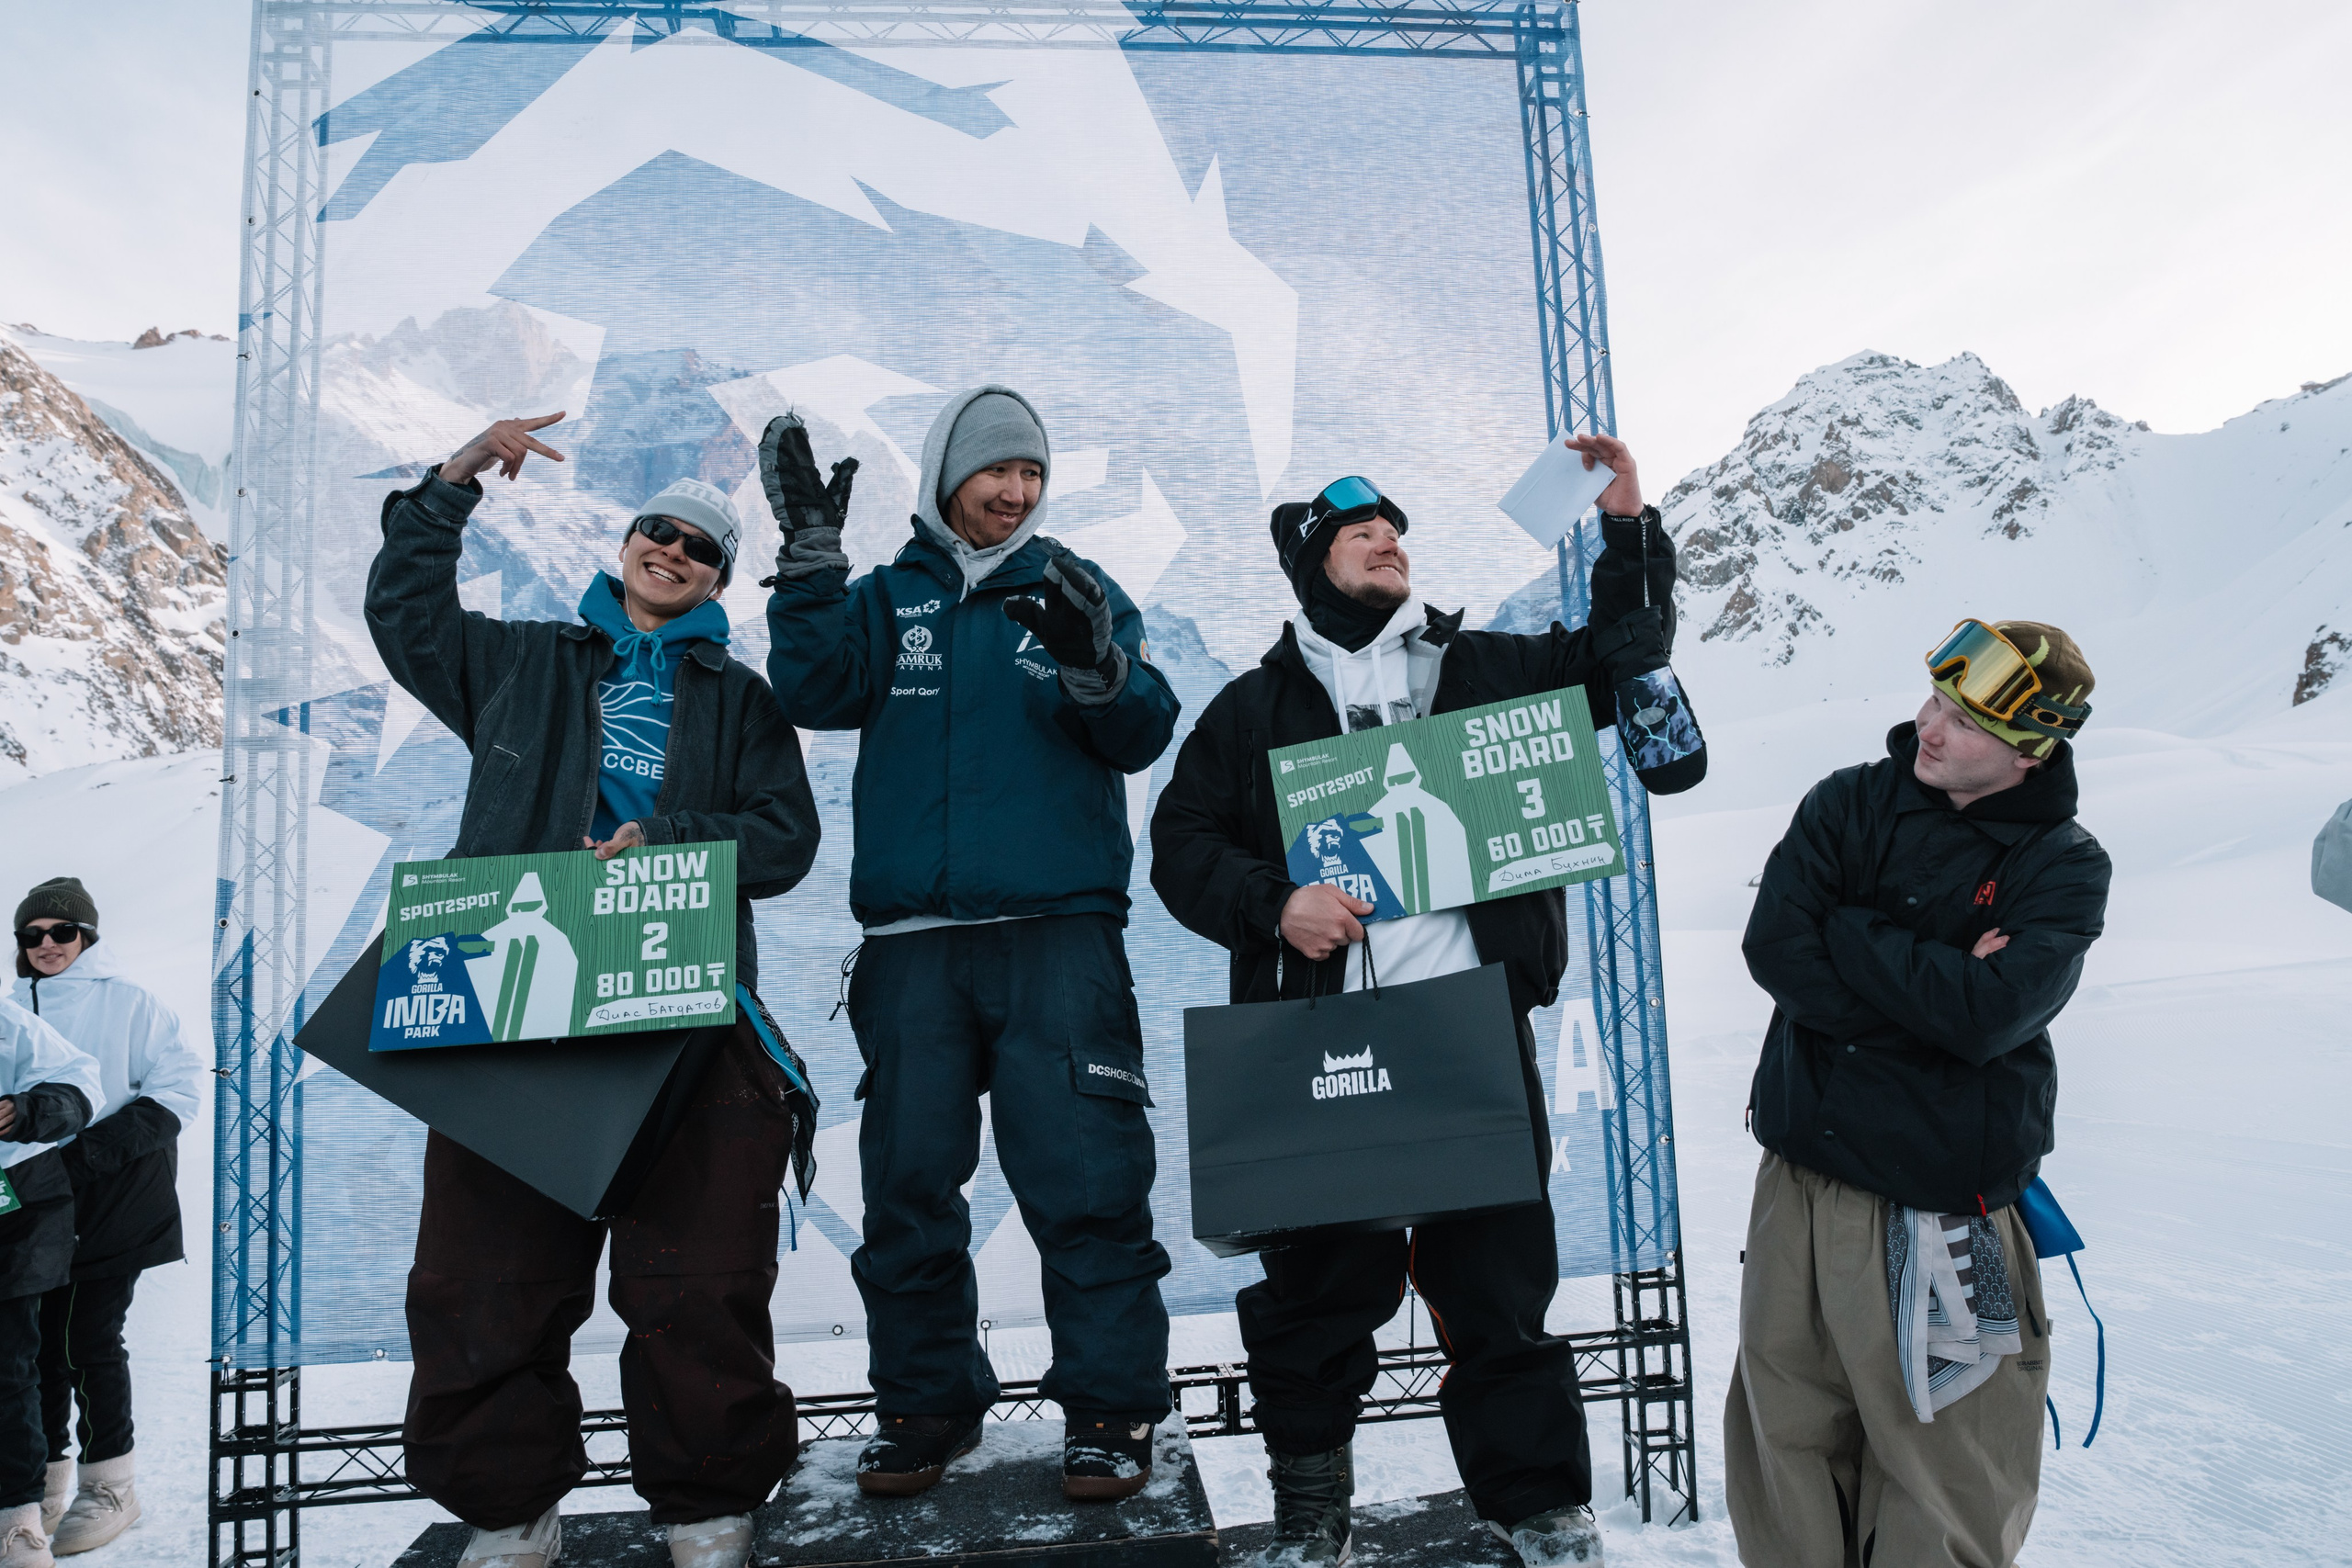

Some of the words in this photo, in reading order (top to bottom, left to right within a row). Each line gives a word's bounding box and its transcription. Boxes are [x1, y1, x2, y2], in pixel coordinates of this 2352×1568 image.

[896, 605, 922, 616] KSA
[897, 654, 943, 664] AMRUK
[1014, 658, 1058, 675] SHYMBULAK
[890, 686, 916, 697] Sport
[1464, 698, 1562, 748] SNOW
[1296, 753, 1329, 764] SHYMBULAK
[1461, 731, 1574, 780] BOARD
[1286, 766, 1374, 808] SPOT2SPOT
[1516, 778, 1545, 819] 3
[1487, 832, 1523, 862] 60
[605, 851, 708, 886] SNOW
[1319, 863, 1349, 878] GORILLA
[1498, 869, 1543, 883] Дима
[400, 891, 501, 921] SPOT2SPOT
[594, 882, 710, 915] BOARD
[641, 922, 668, 961] 2
[411, 982, 443, 994] GORILLA
[597, 973, 634, 998] 80
[404, 1025, 440, 1039] PARK
[1311, 1067, 1393, 1100] GORILLA
